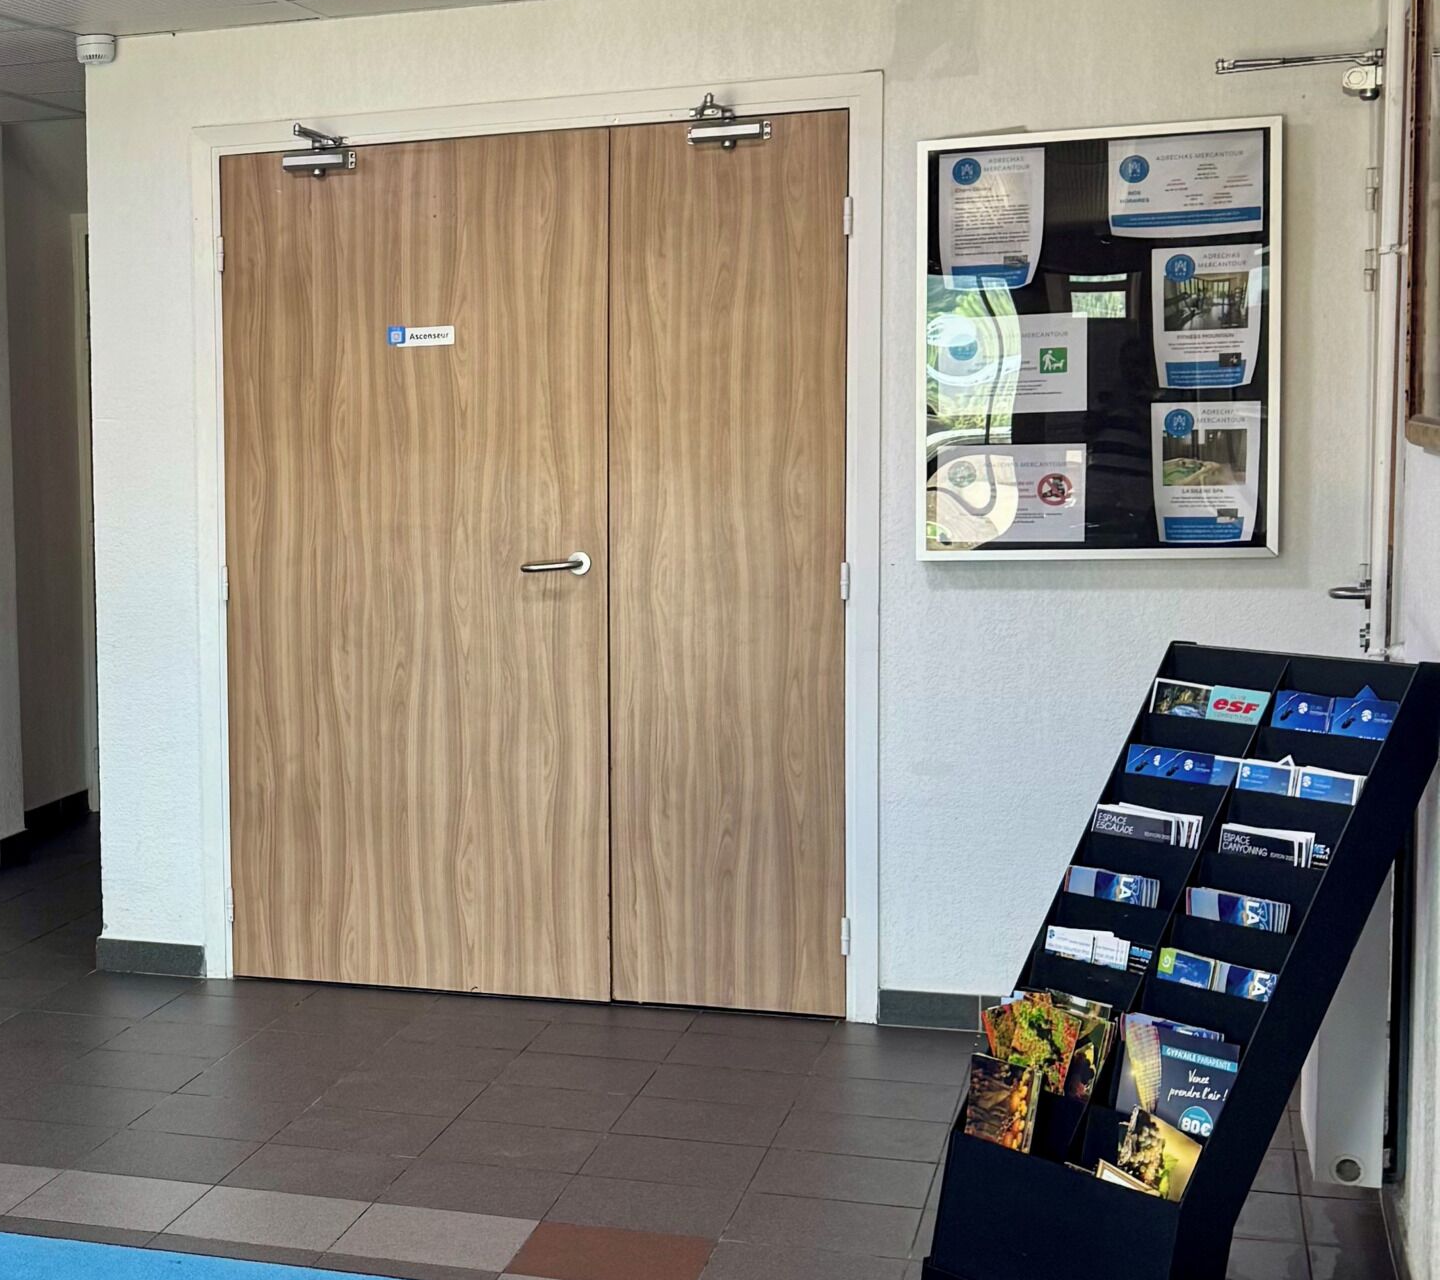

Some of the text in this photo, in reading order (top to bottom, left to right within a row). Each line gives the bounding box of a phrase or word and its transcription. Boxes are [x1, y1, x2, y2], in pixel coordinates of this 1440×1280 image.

[1098, 812, 1128, 826] ESPACE
[1095, 821, 1134, 836] ESCALADE
[1223, 832, 1251, 846] ESPACE
[1222, 841, 1268, 857] CANYONING
[1188, 1068, 1210, 1085] Venez
[1167, 1087, 1201, 1101] prendre
[1181, 1118, 1211, 1137] 80€
